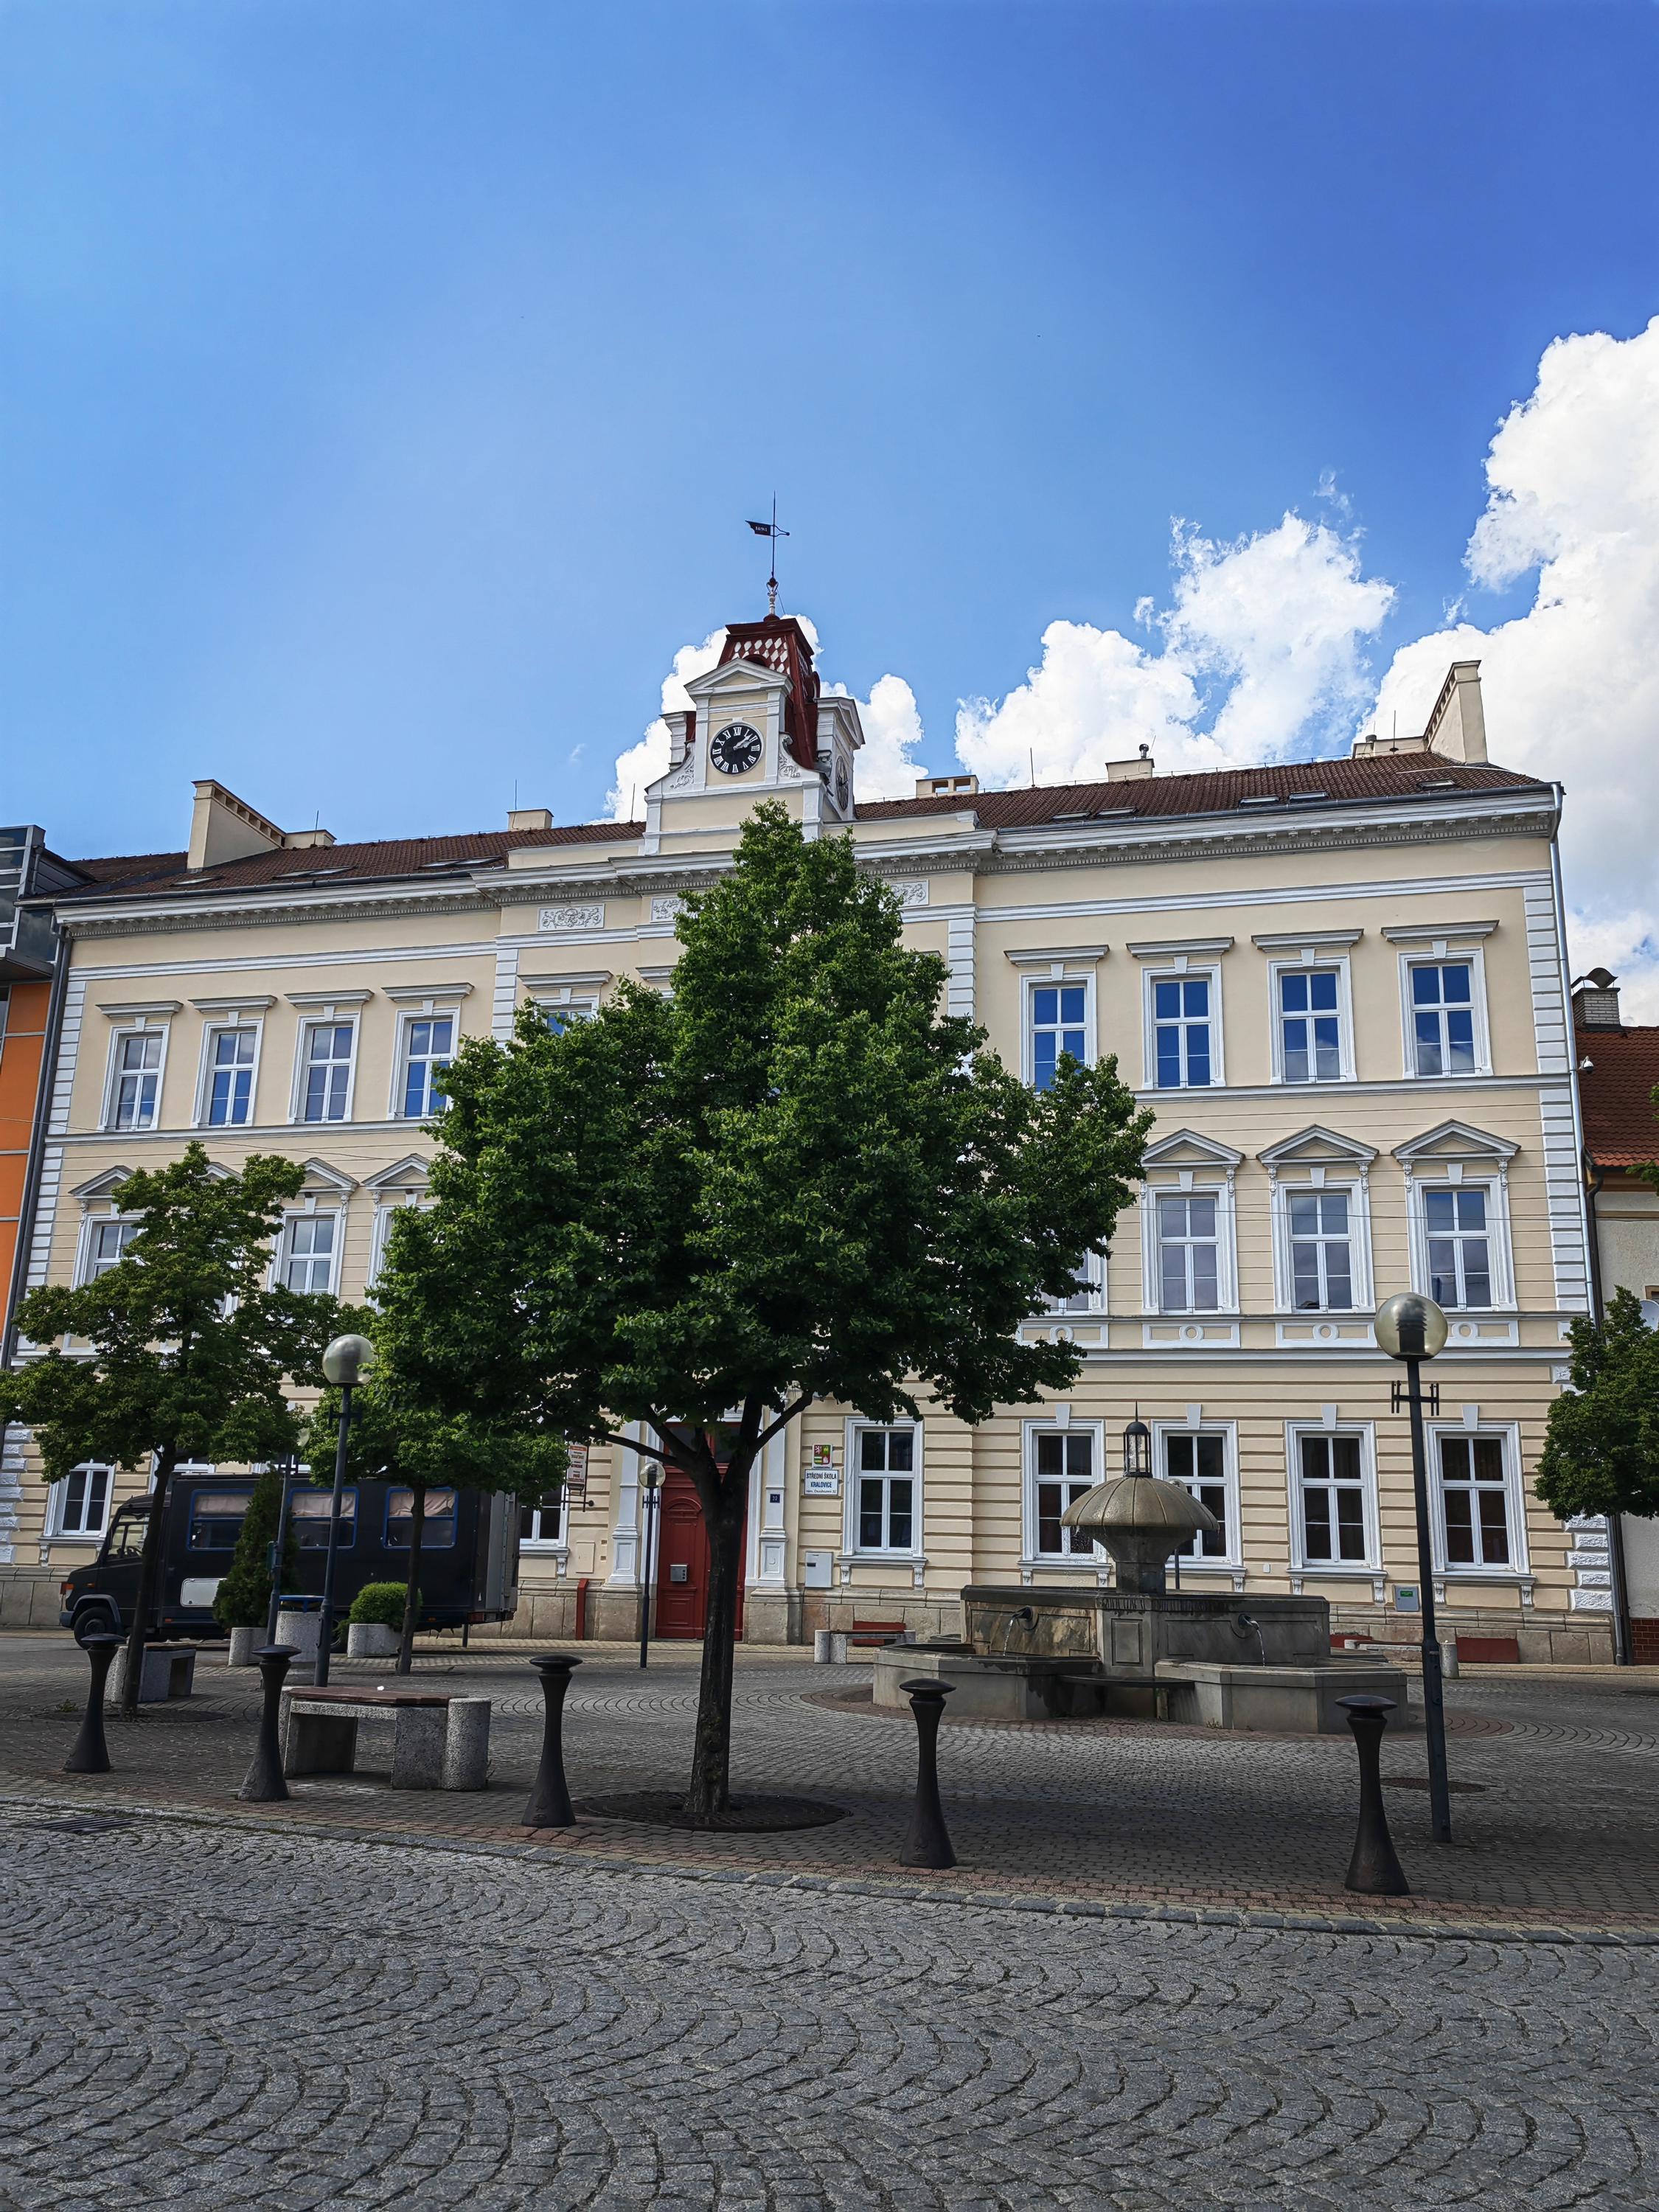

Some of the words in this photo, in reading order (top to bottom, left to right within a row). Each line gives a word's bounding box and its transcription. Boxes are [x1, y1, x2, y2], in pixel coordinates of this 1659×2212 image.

[723, 730, 731, 740] XI
[733, 727, 742, 736] XII
[715, 738, 726, 746] X
[732, 764, 739, 773] VI
[742, 761, 749, 770] V
